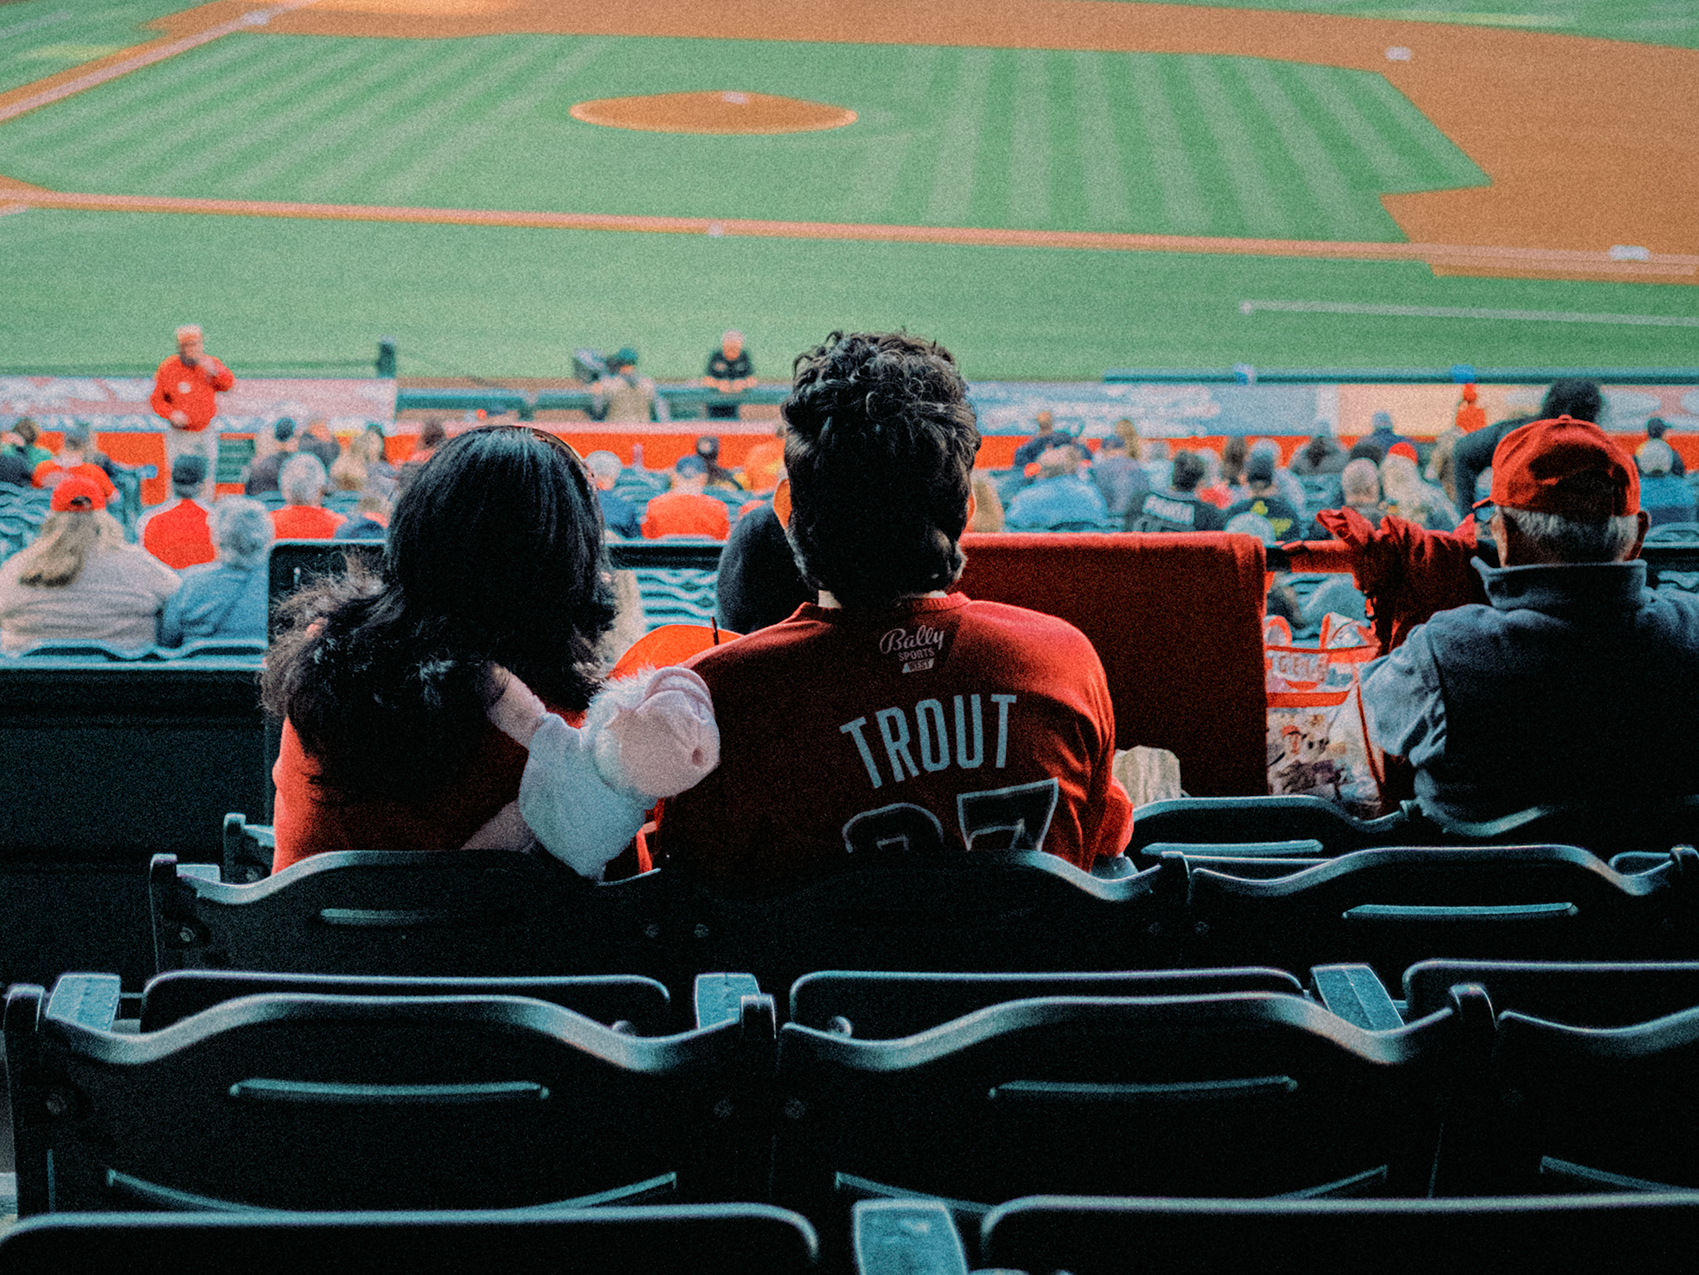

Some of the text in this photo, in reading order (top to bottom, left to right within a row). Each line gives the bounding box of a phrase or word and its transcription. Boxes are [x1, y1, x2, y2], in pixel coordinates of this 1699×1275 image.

[879, 624, 945, 654] Bally
[898, 647, 935, 662] SPORTS
[839, 694, 1017, 788] TROUT
